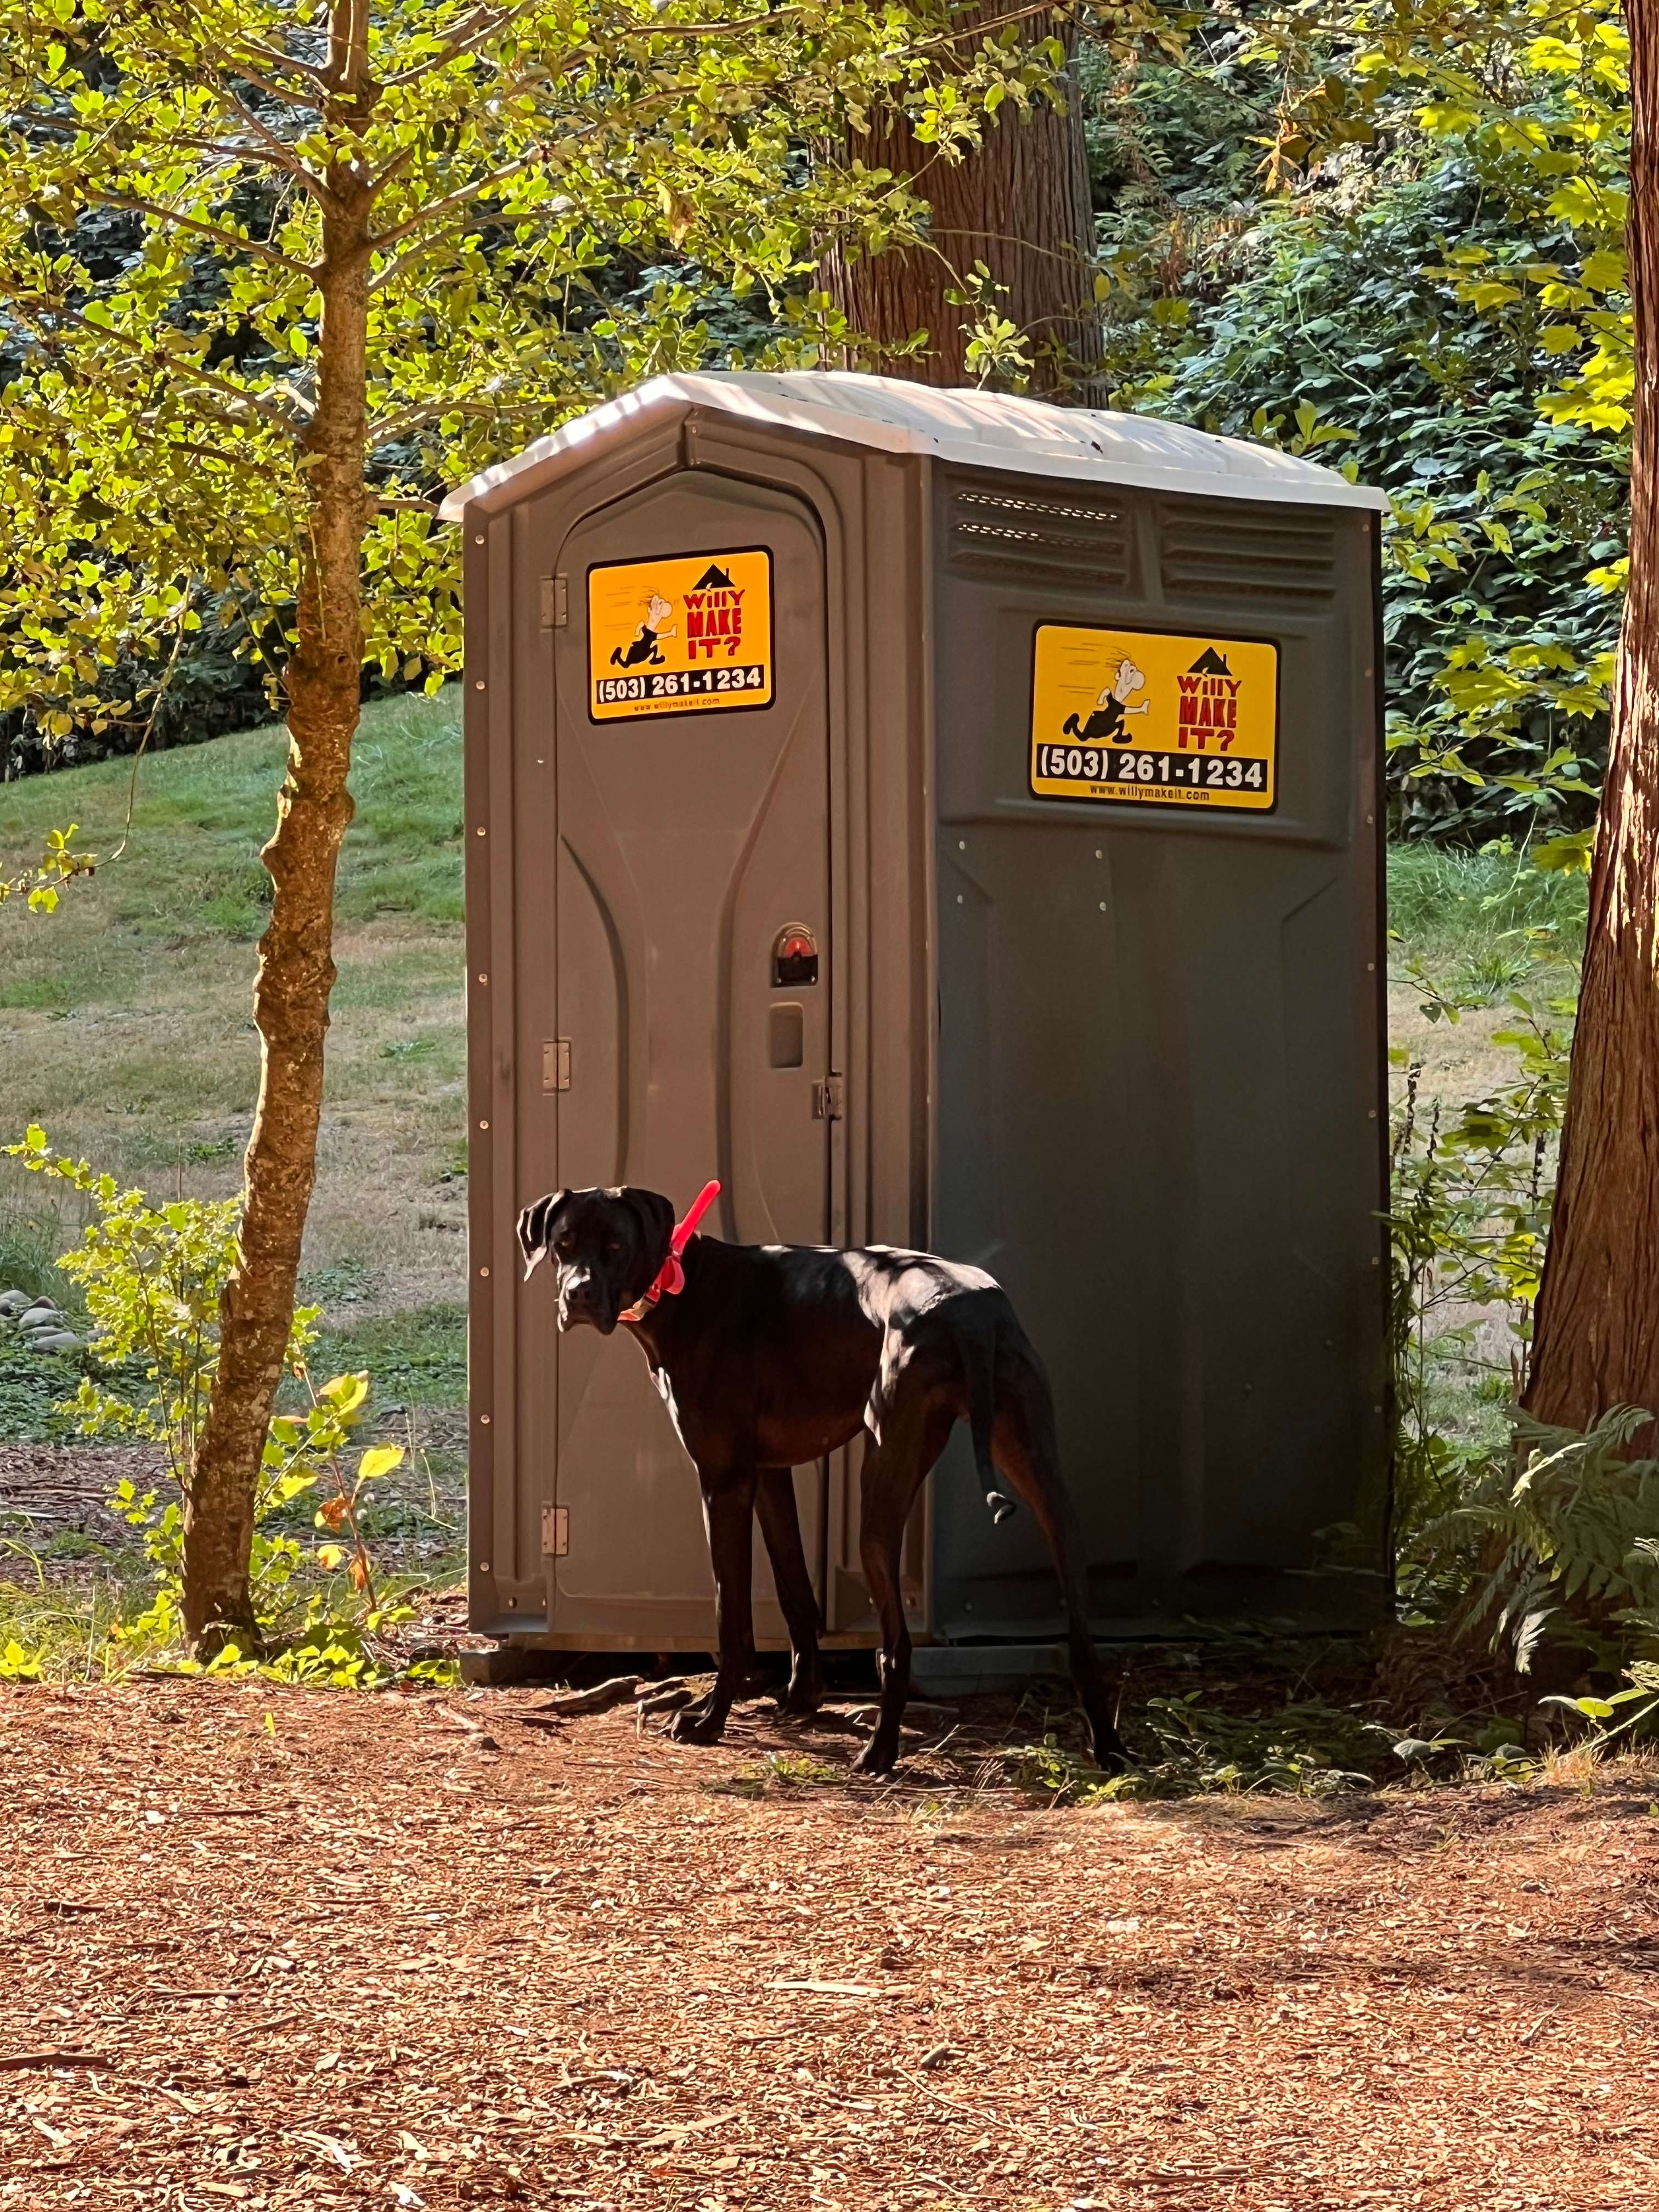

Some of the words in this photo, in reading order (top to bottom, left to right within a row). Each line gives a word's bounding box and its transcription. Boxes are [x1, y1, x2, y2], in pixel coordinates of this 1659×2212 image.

[687, 608, 742, 638] MAKE
[688, 636, 741, 660] IT?
[599, 676, 646, 703] (503)
[652, 667, 761, 696] 261-1234
[1179, 696, 1237, 728] MAKE
[1178, 727, 1234, 751] IT?
[1042, 746, 1108, 780] (503)
[1119, 753, 1262, 788] 261-1234
[1090, 784, 1210, 801] www.willymakeit.com
